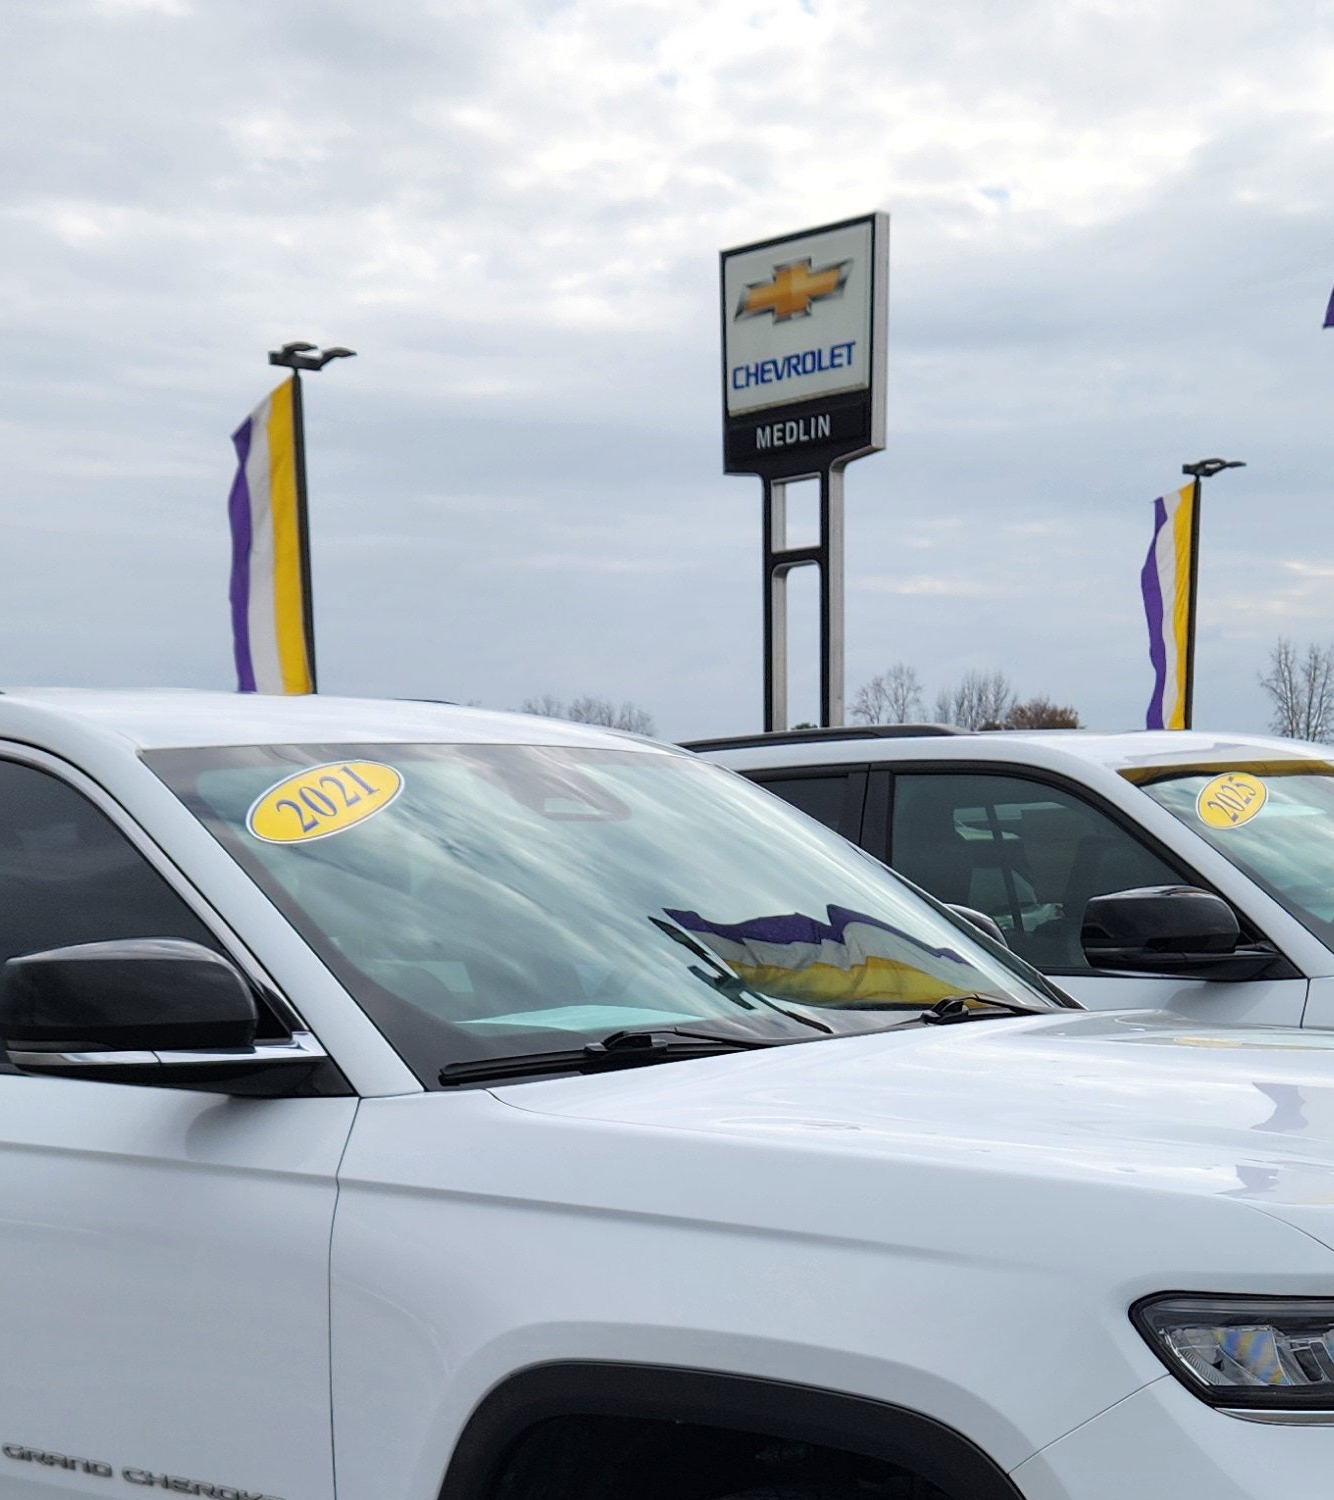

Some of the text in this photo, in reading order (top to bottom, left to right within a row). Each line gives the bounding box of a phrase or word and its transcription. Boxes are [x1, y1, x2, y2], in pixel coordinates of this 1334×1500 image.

[732, 341, 856, 390] CHEVROLET
[756, 414, 831, 449] MEDLIN
[275, 765, 381, 833] 2021
[1, 1442, 113, 1477] GRAND
